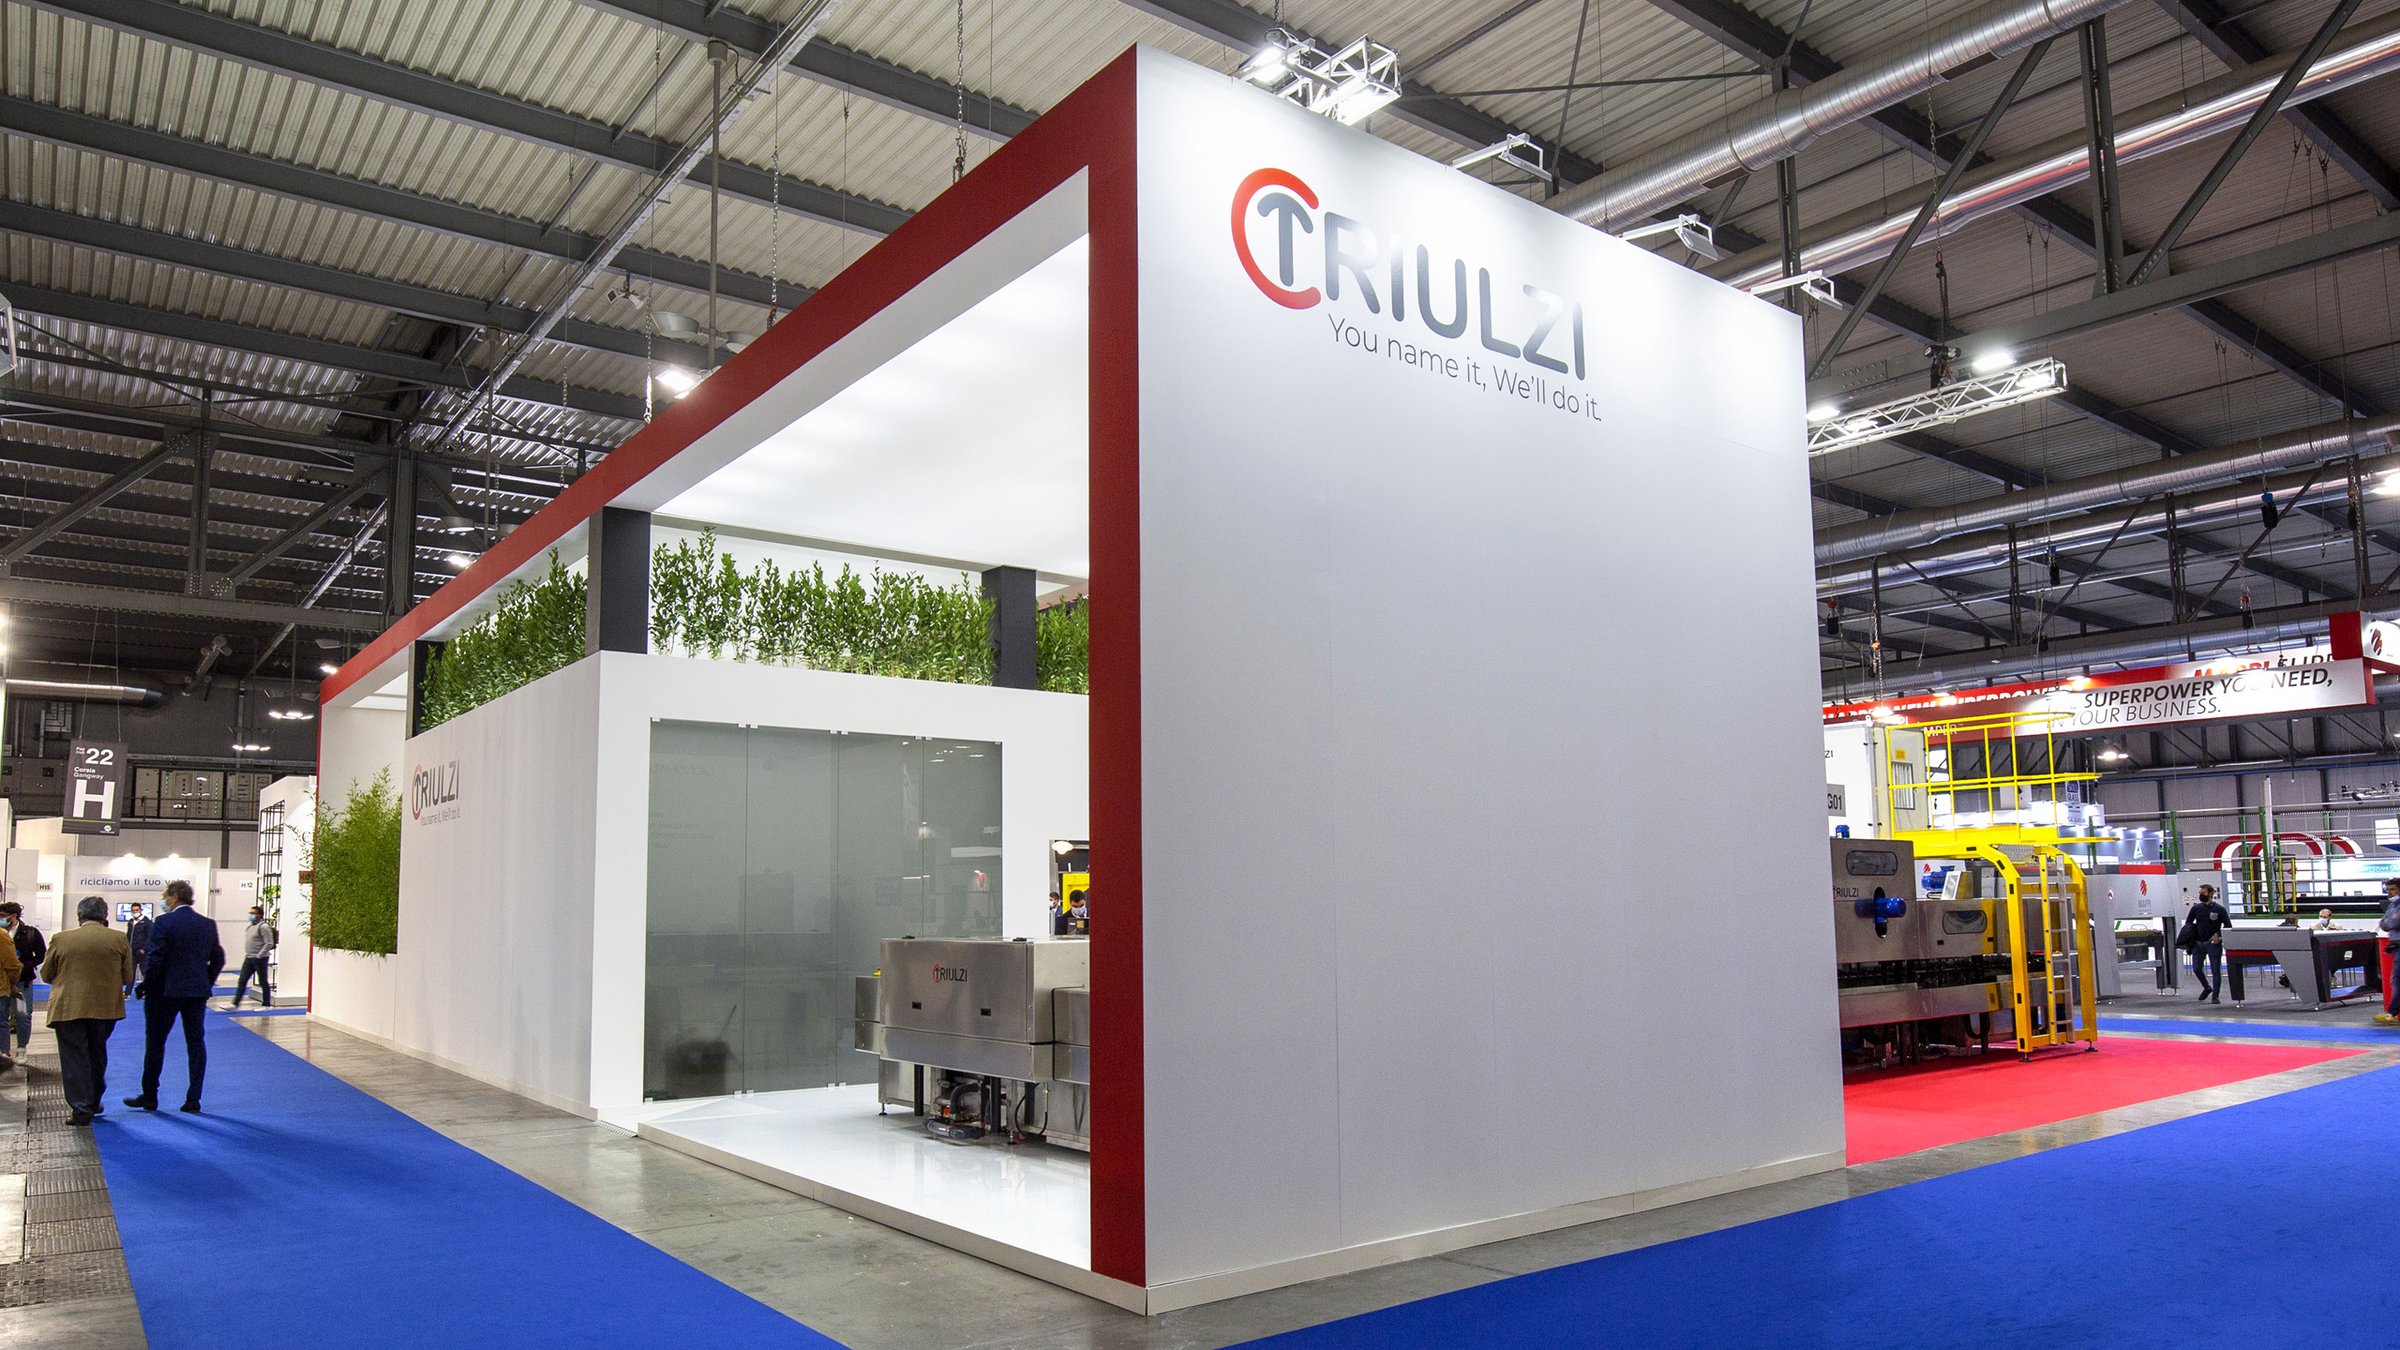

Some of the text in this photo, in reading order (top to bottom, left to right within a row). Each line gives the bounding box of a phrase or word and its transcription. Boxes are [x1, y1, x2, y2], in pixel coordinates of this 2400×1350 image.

[1256, 192, 1585, 381] TRIULZI
[1328, 313, 1602, 422] You name it, We'll do it.
[2084, 680, 2214, 708] SUPERPOWER
[2271, 668, 2333, 688] NEED,
[2126, 697, 2221, 721] BUSINESS.
[85, 748, 114, 766] 22
[73, 779, 115, 819] H
[414, 759, 460, 812] TRIULZI
[80, 877, 130, 886] ricicliamo
[134, 877, 140, 886] il
[144, 878, 161, 886] tuo
[935, 967, 968, 982] TRIULZI
